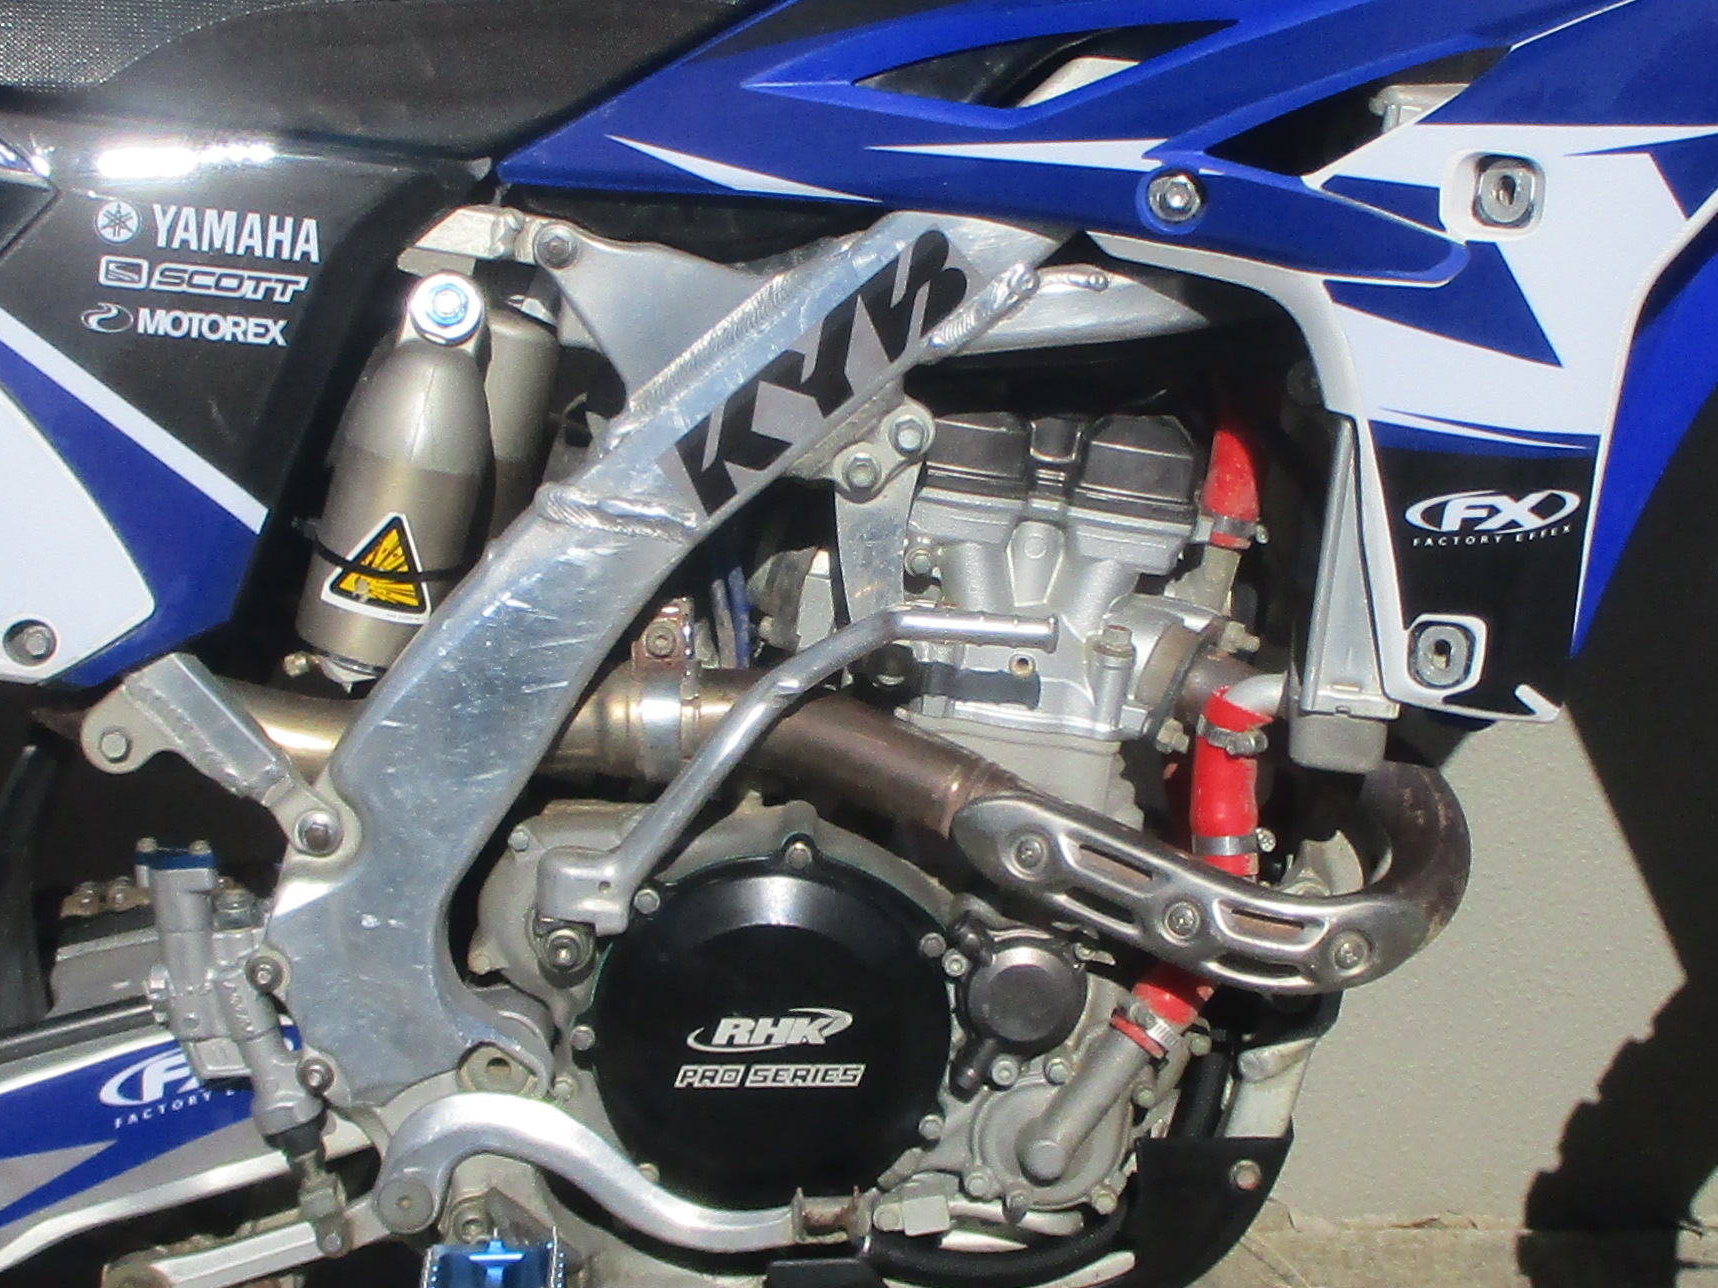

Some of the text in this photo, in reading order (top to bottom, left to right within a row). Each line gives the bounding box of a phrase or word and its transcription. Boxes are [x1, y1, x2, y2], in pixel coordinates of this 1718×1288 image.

[152, 203, 322, 264] YAMAHA
[149, 261, 310, 304] SCOTT
[136, 306, 289, 347] MOTOREX
[674, 229, 969, 518] KYB
[1439, 491, 1552, 533] FX
[1412, 523, 1573, 548] FACTORY EFFEX
[710, 1016, 835, 1046] RHK
[674, 1063, 867, 1089] PRO SERIES
[113, 1090, 214, 1130] FACTORY
